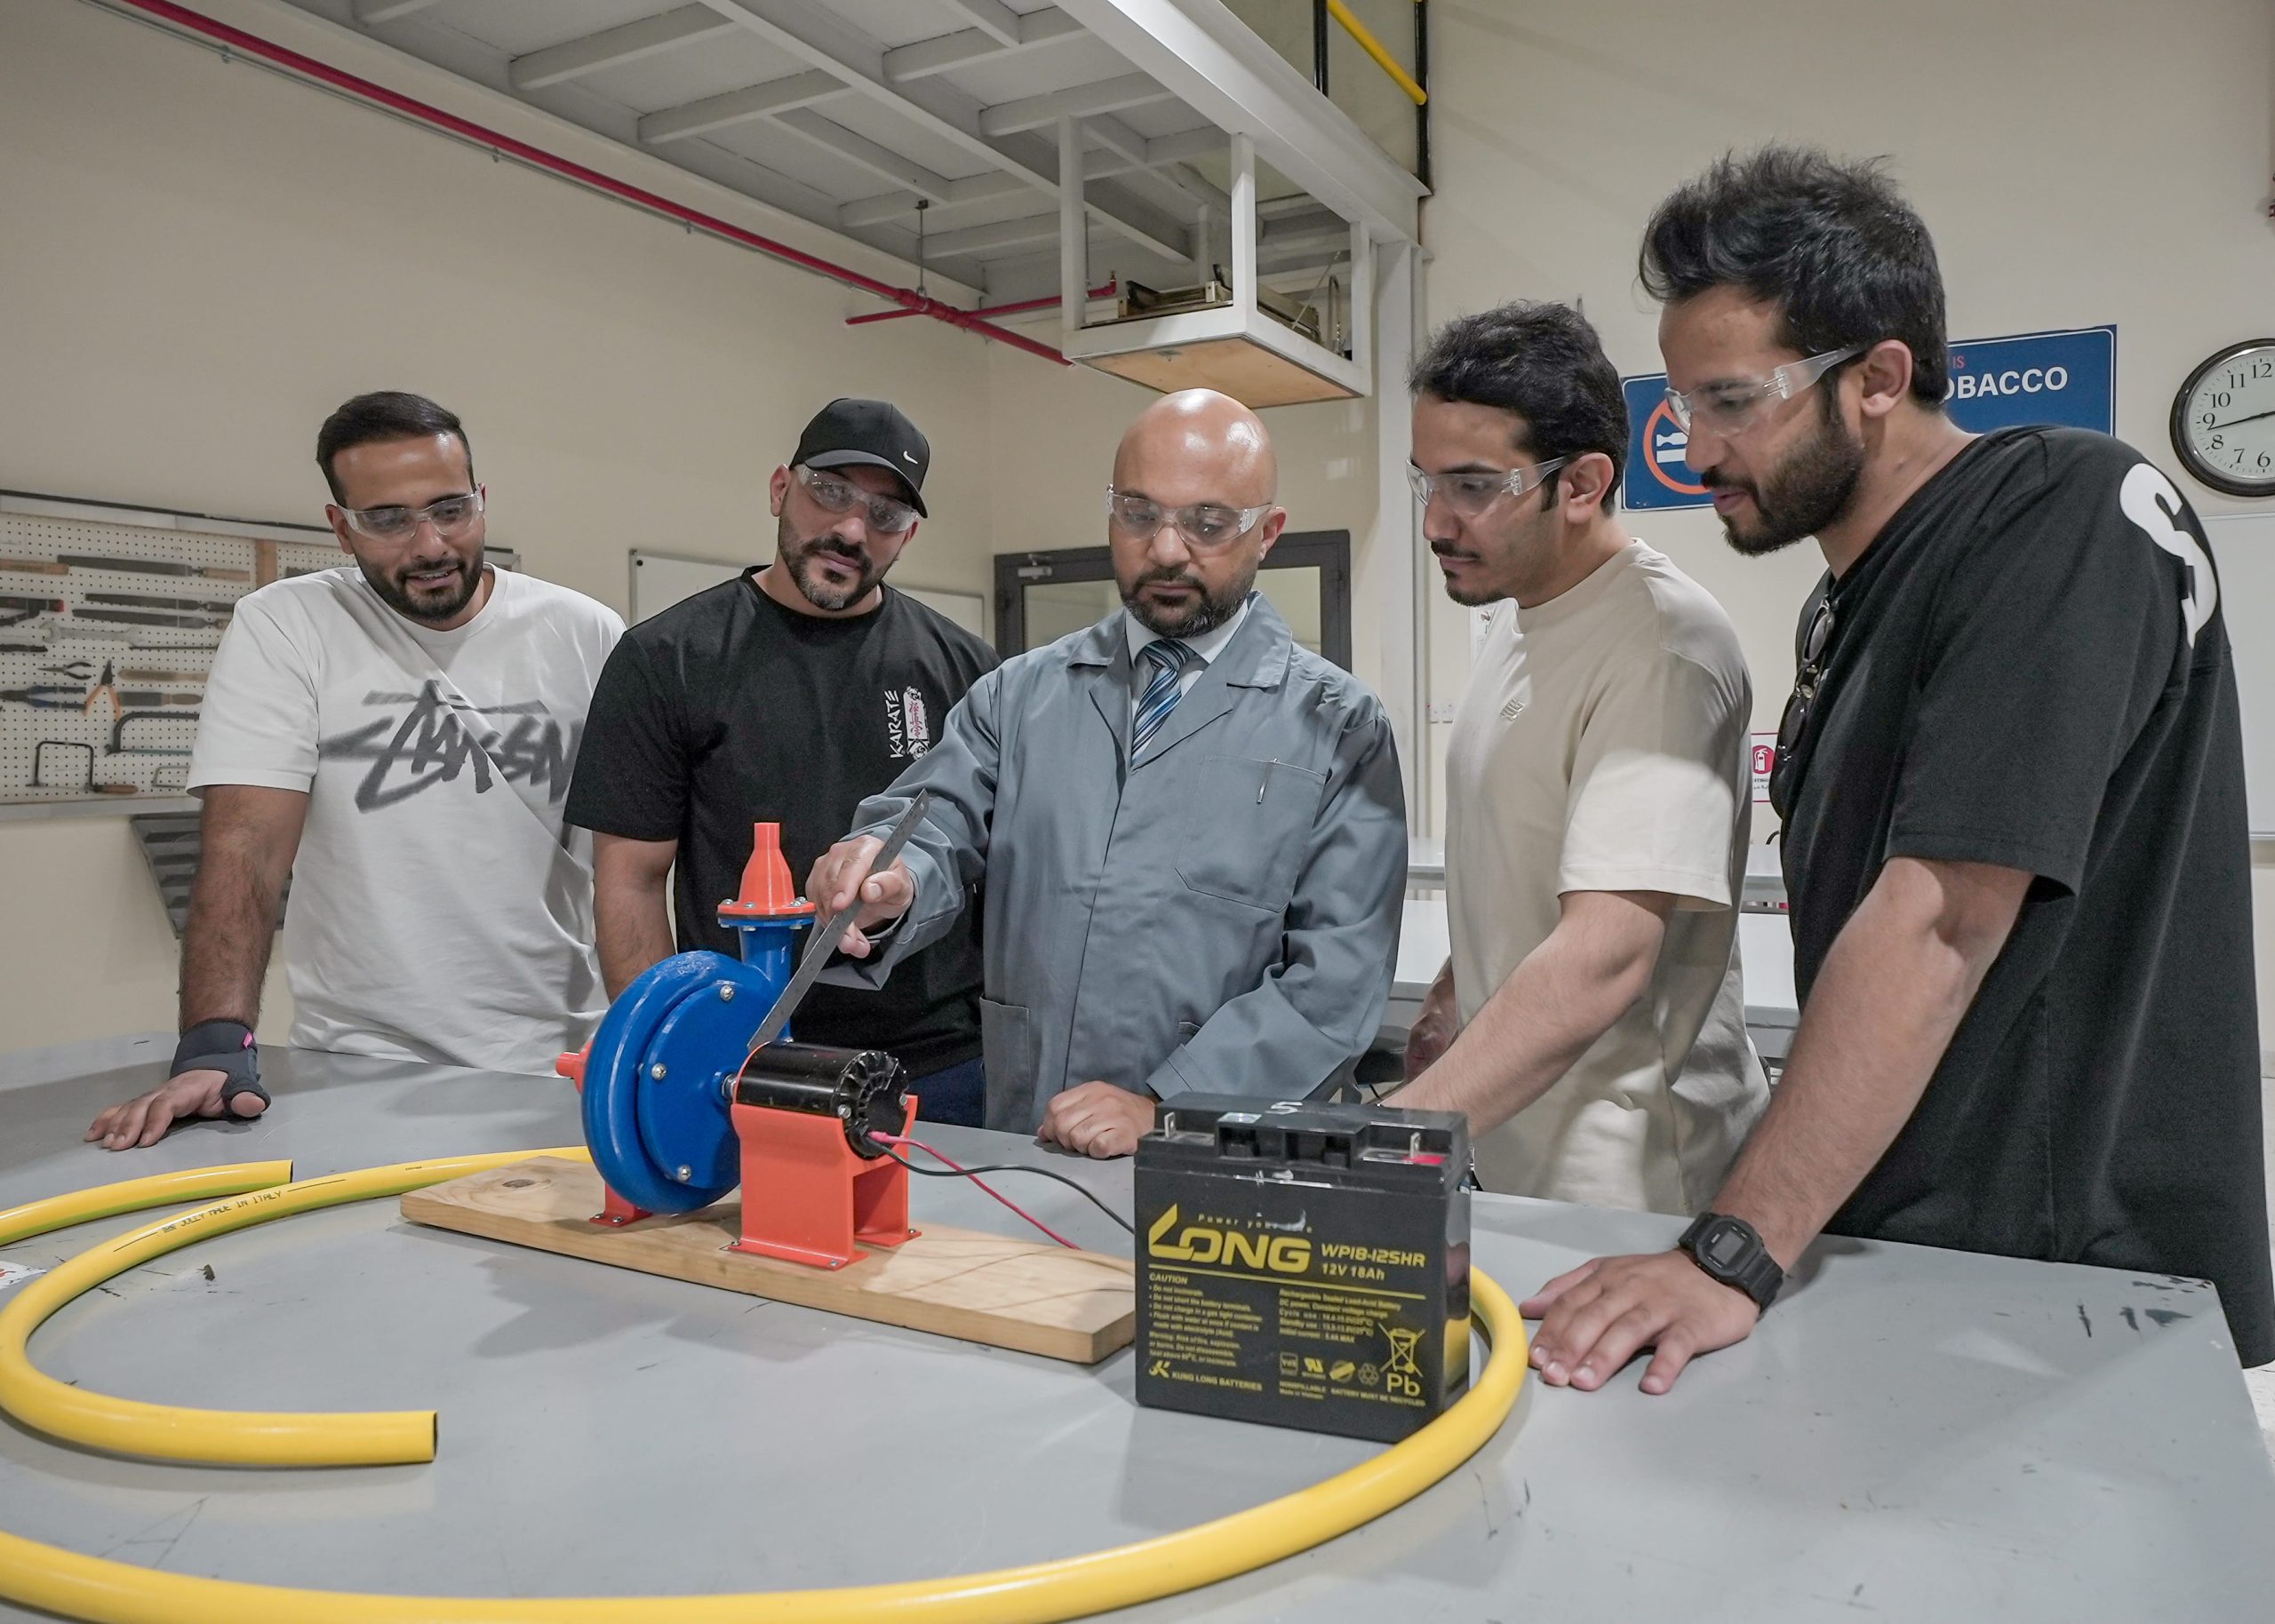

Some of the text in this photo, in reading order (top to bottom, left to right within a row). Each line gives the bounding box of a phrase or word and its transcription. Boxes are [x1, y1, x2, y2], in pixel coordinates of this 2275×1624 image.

[2252, 362, 2272, 379] 12
[2230, 373, 2246, 389] 11
[2211, 392, 2231, 409] 10
[2202, 412, 2216, 430] 9
[2211, 434, 2224, 450] 8
[2233, 448, 2245, 464] 7
[2257, 451, 2271, 468] 6
[884, 690, 904, 758] KARATE
[236, 1199, 248, 1209] IN
[252, 1190, 283, 1205] ITALY
[1147, 1202, 1312, 1273] LONG
[1149, 1272, 1187, 1285] CAUTION
[1322, 1262, 1385, 1281] 12V 18Ah
[1195, 1373, 1218, 1386] LONG
[1218, 1376, 1263, 1391] BATTERIES
[1386, 1372, 1421, 1397] Pb
